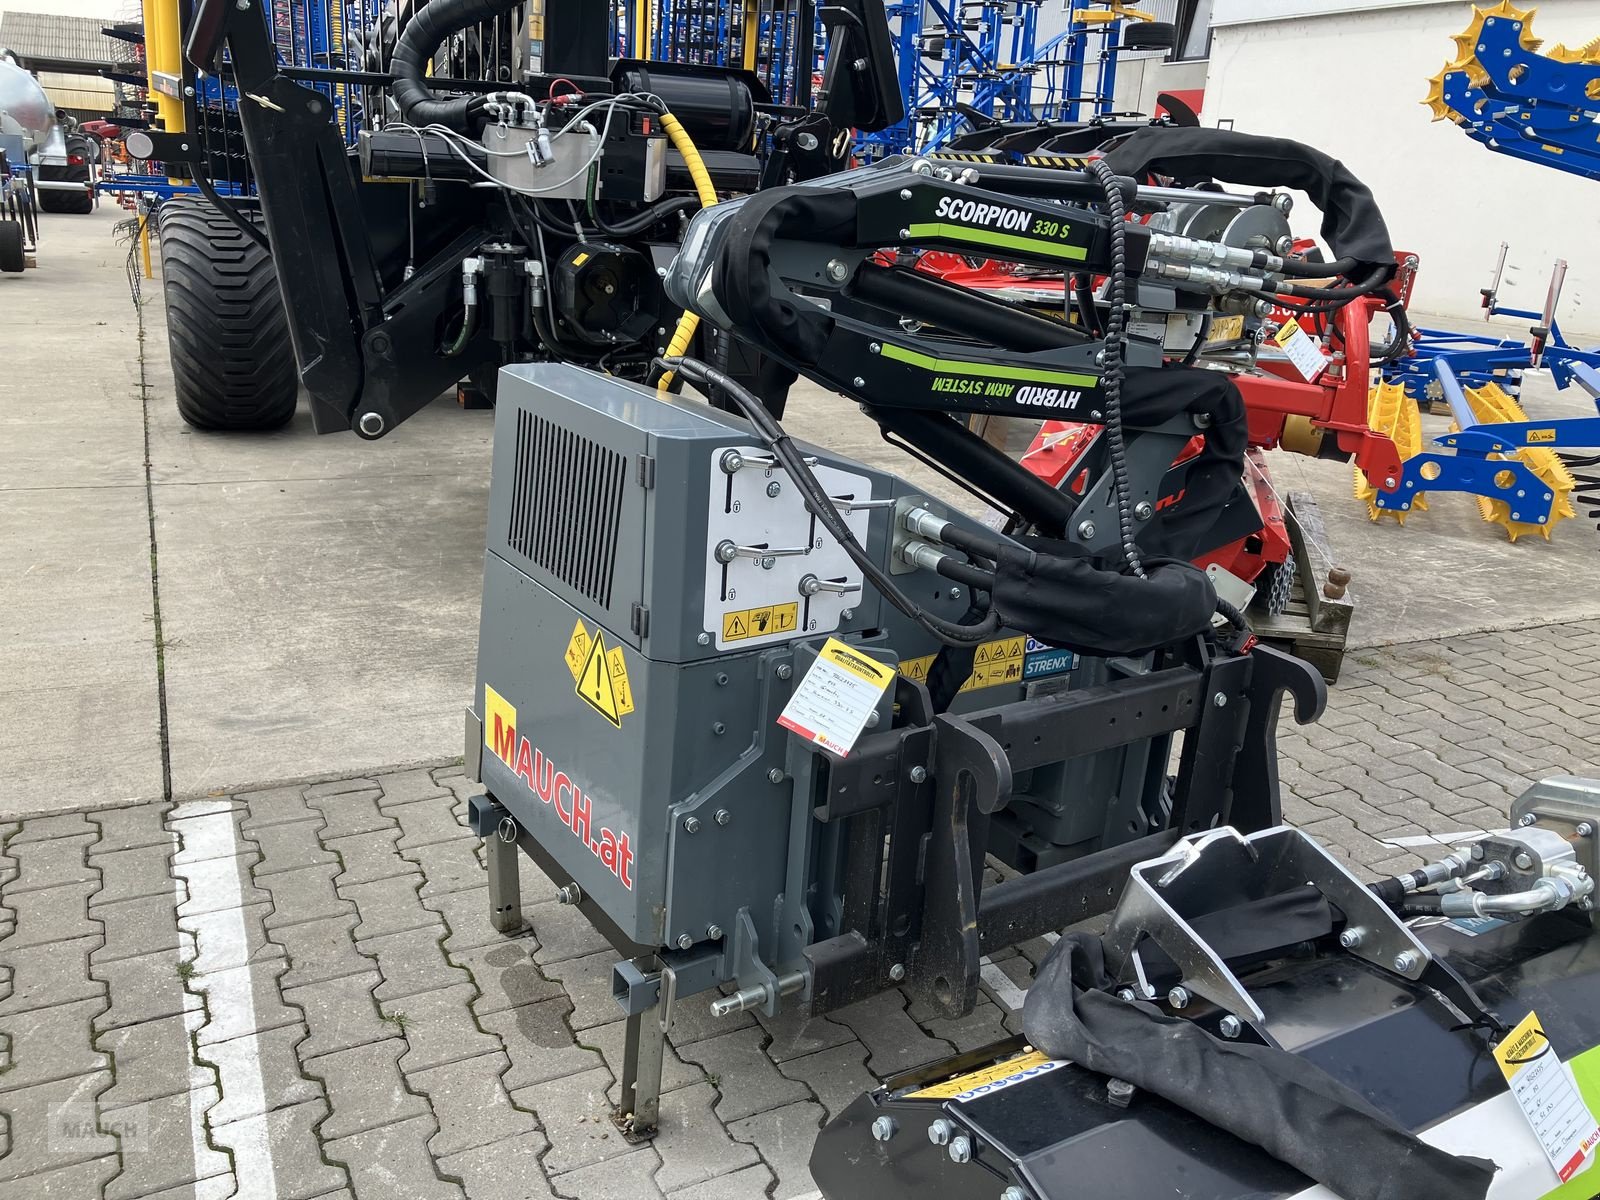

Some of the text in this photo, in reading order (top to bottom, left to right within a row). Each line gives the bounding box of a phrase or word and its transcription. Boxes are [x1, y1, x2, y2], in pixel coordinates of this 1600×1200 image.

[935, 196, 1071, 239] SCORPION 330 S
[931, 377, 1081, 409] HYBRID ARM SYSTEM
[1026, 655, 1068, 674] STRENX
[818, 735, 844, 753] MAUCH
[494, 712, 634, 891] MAUCH.at
[1582, 1128, 1599, 1152] MAUCH
